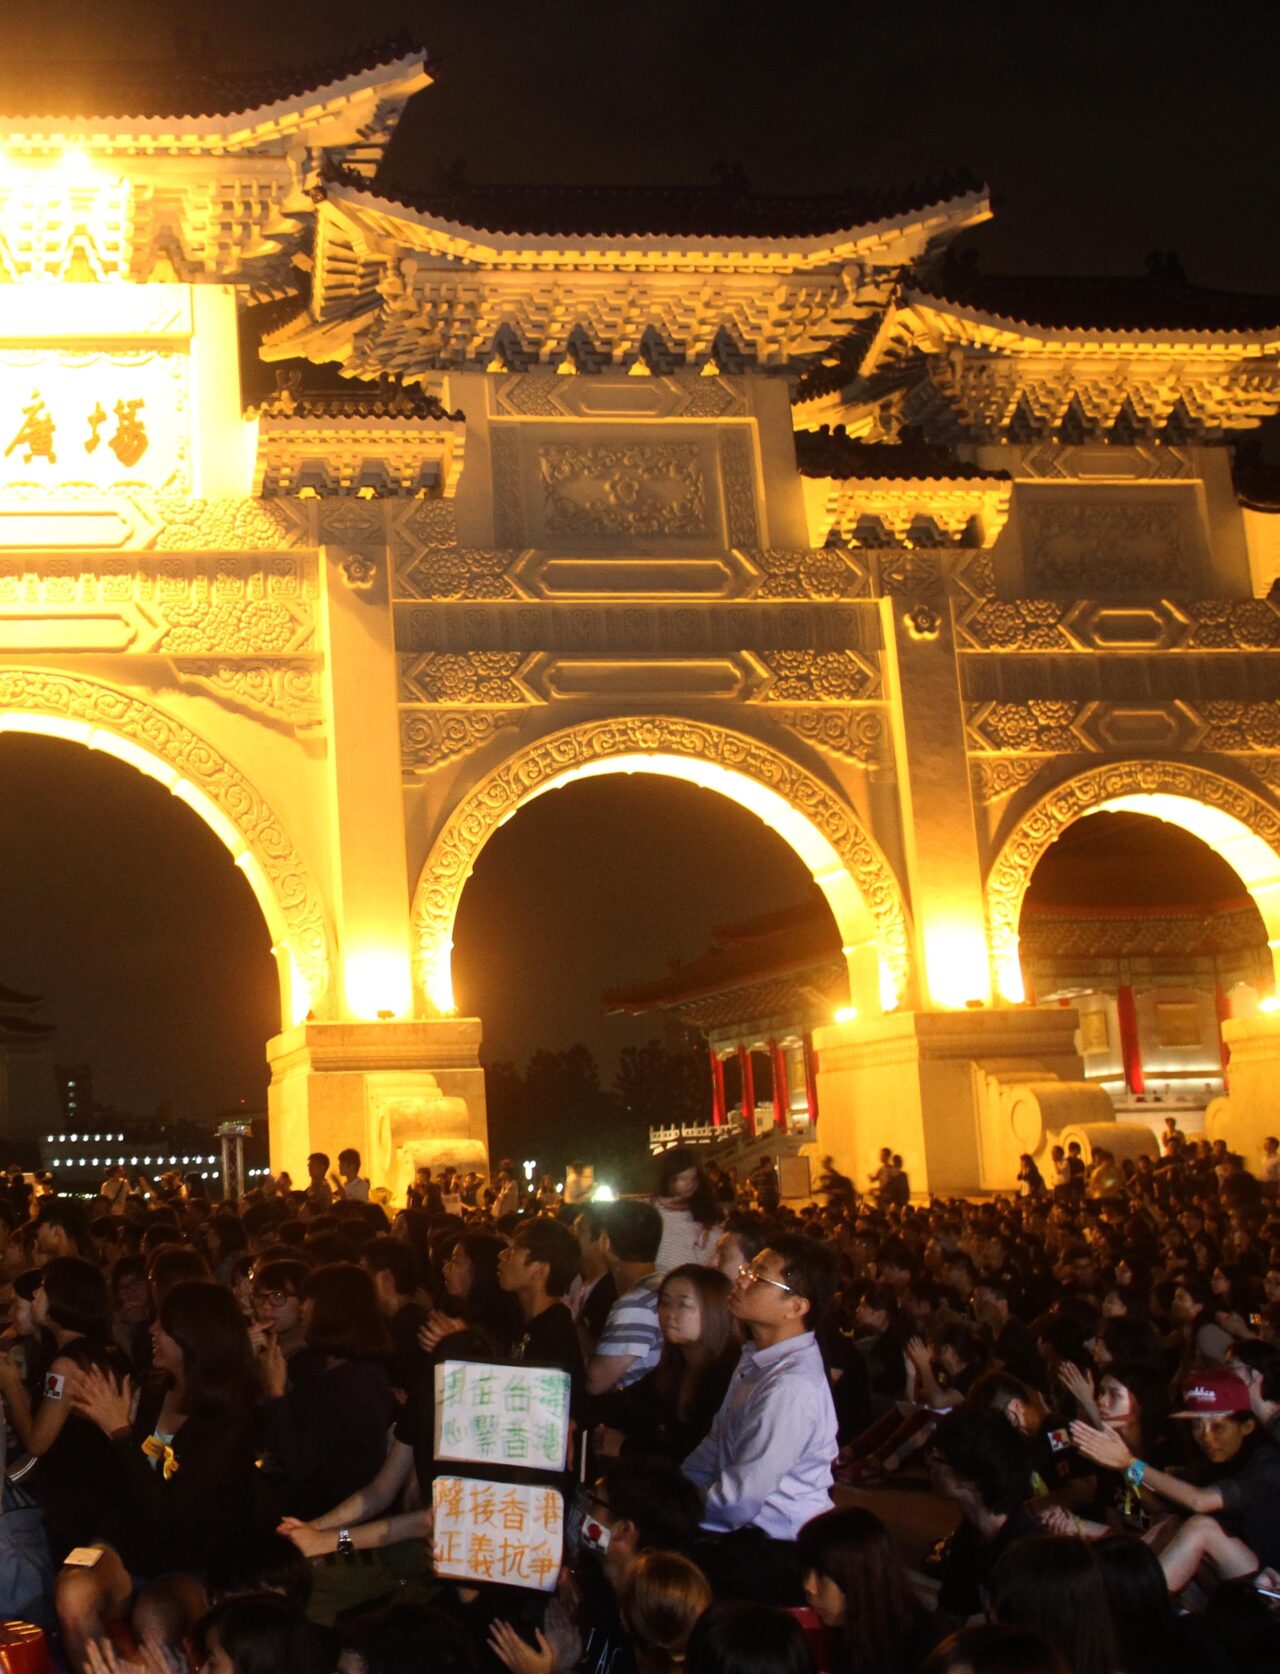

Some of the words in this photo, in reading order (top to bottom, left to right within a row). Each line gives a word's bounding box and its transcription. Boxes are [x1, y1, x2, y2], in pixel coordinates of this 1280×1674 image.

[433, 1477, 562, 1535] 聲援香港
[434, 1530, 561, 1588] 正義抗爭
